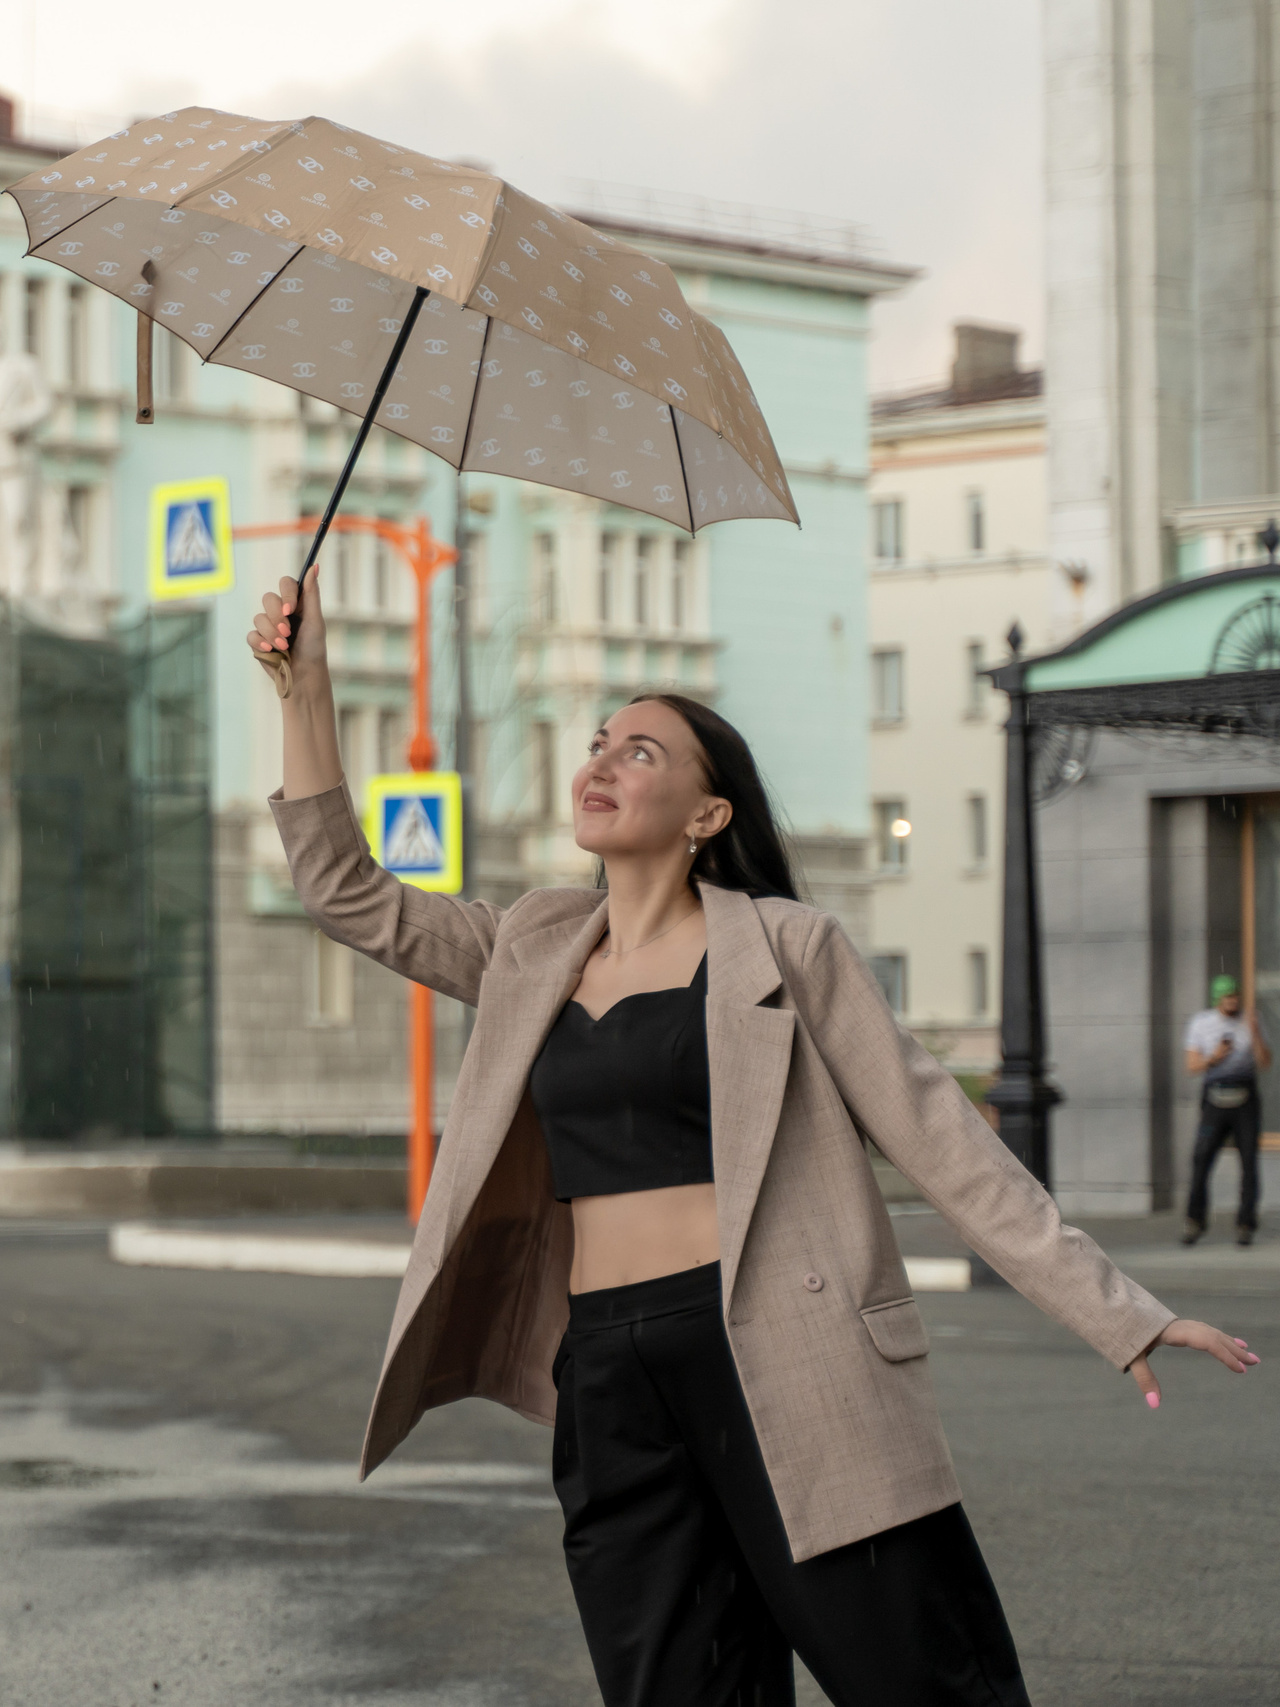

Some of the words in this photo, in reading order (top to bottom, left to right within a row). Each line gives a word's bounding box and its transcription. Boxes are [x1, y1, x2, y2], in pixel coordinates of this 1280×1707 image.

[245, 176, 276, 190] CHANEL
[301, 196, 330, 209] CHANEL
[358, 215, 388, 229] CHANEL
[418, 236, 448, 249] CHANEL
